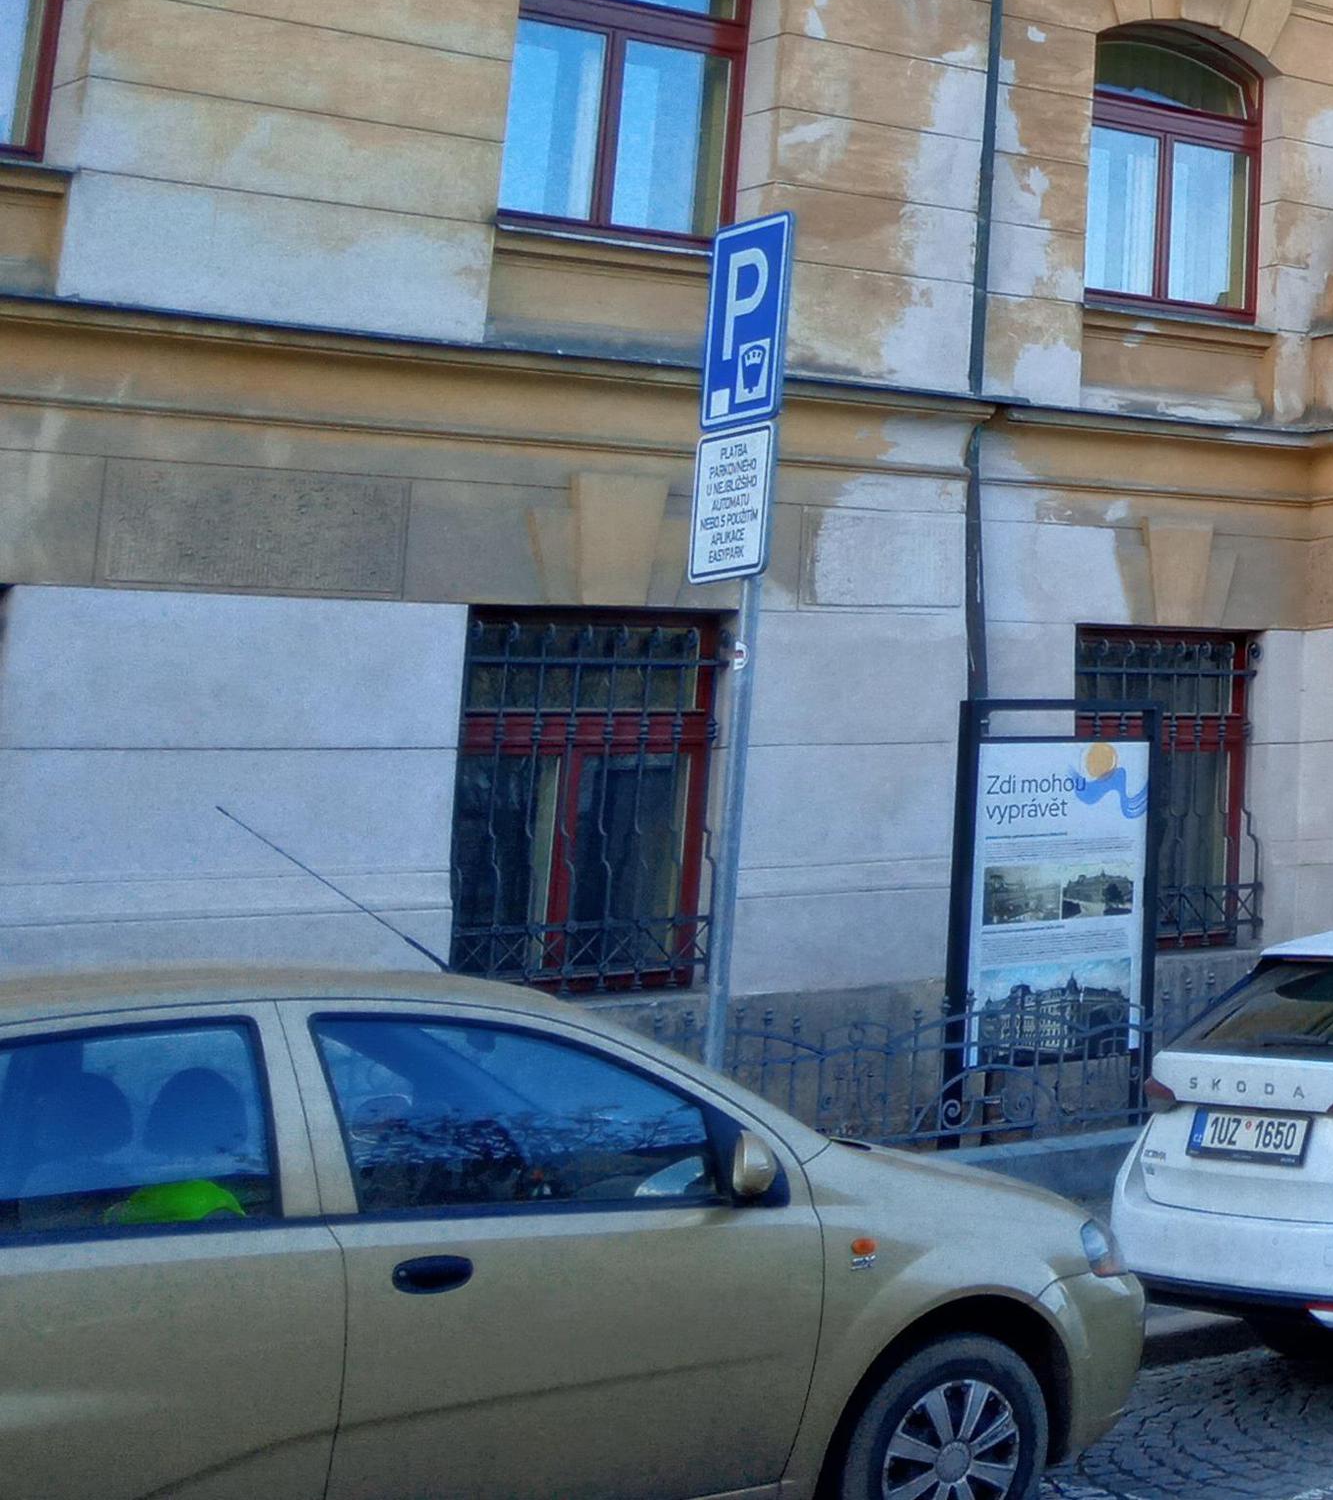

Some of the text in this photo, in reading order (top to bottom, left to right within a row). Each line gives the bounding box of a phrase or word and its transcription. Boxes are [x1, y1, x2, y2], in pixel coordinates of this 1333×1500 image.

[722, 247, 769, 361] P
[720, 443, 748, 460] PLATBA
[700, 515, 720, 531] NEBO
[711, 528, 746, 545] APLIKACE
[986, 773, 1086, 795] Zdi mohou
[986, 797, 1068, 825] vyprávět
[1210, 1116, 1297, 1151] 1UZ 1650
